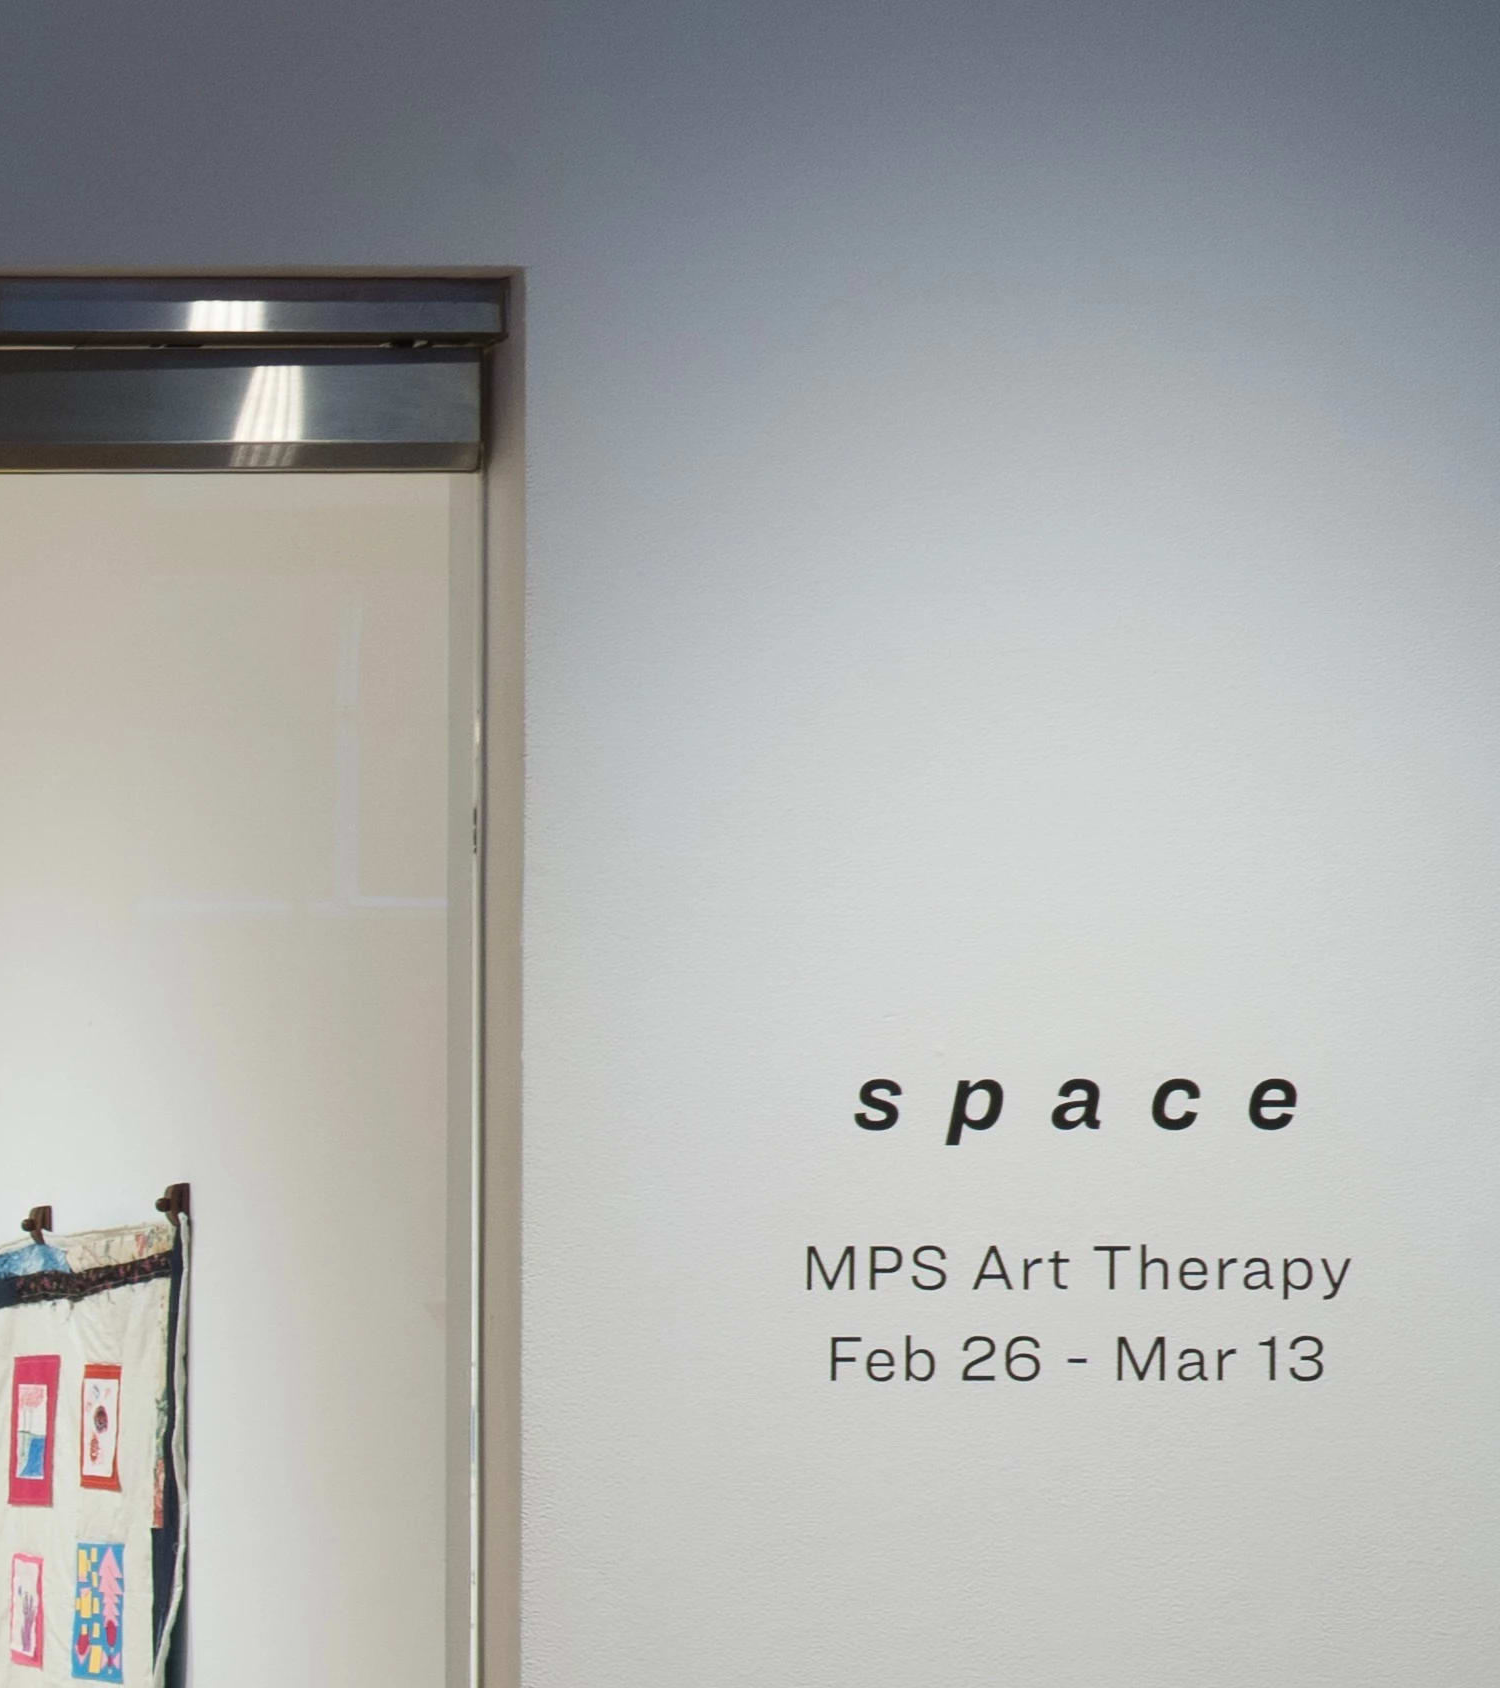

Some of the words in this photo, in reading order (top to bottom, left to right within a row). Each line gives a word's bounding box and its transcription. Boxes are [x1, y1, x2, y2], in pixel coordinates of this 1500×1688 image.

[855, 1079, 1297, 1145] space
[807, 1246, 946, 1290] MPS
[973, 1246, 1069, 1289] Art
[1094, 1245, 1350, 1299] Therapy
[831, 1335, 934, 1381] Feb
[963, 1336, 1040, 1381] 26
[1118, 1337, 1236, 1381] Mar
[1260, 1336, 1323, 1381] 13
